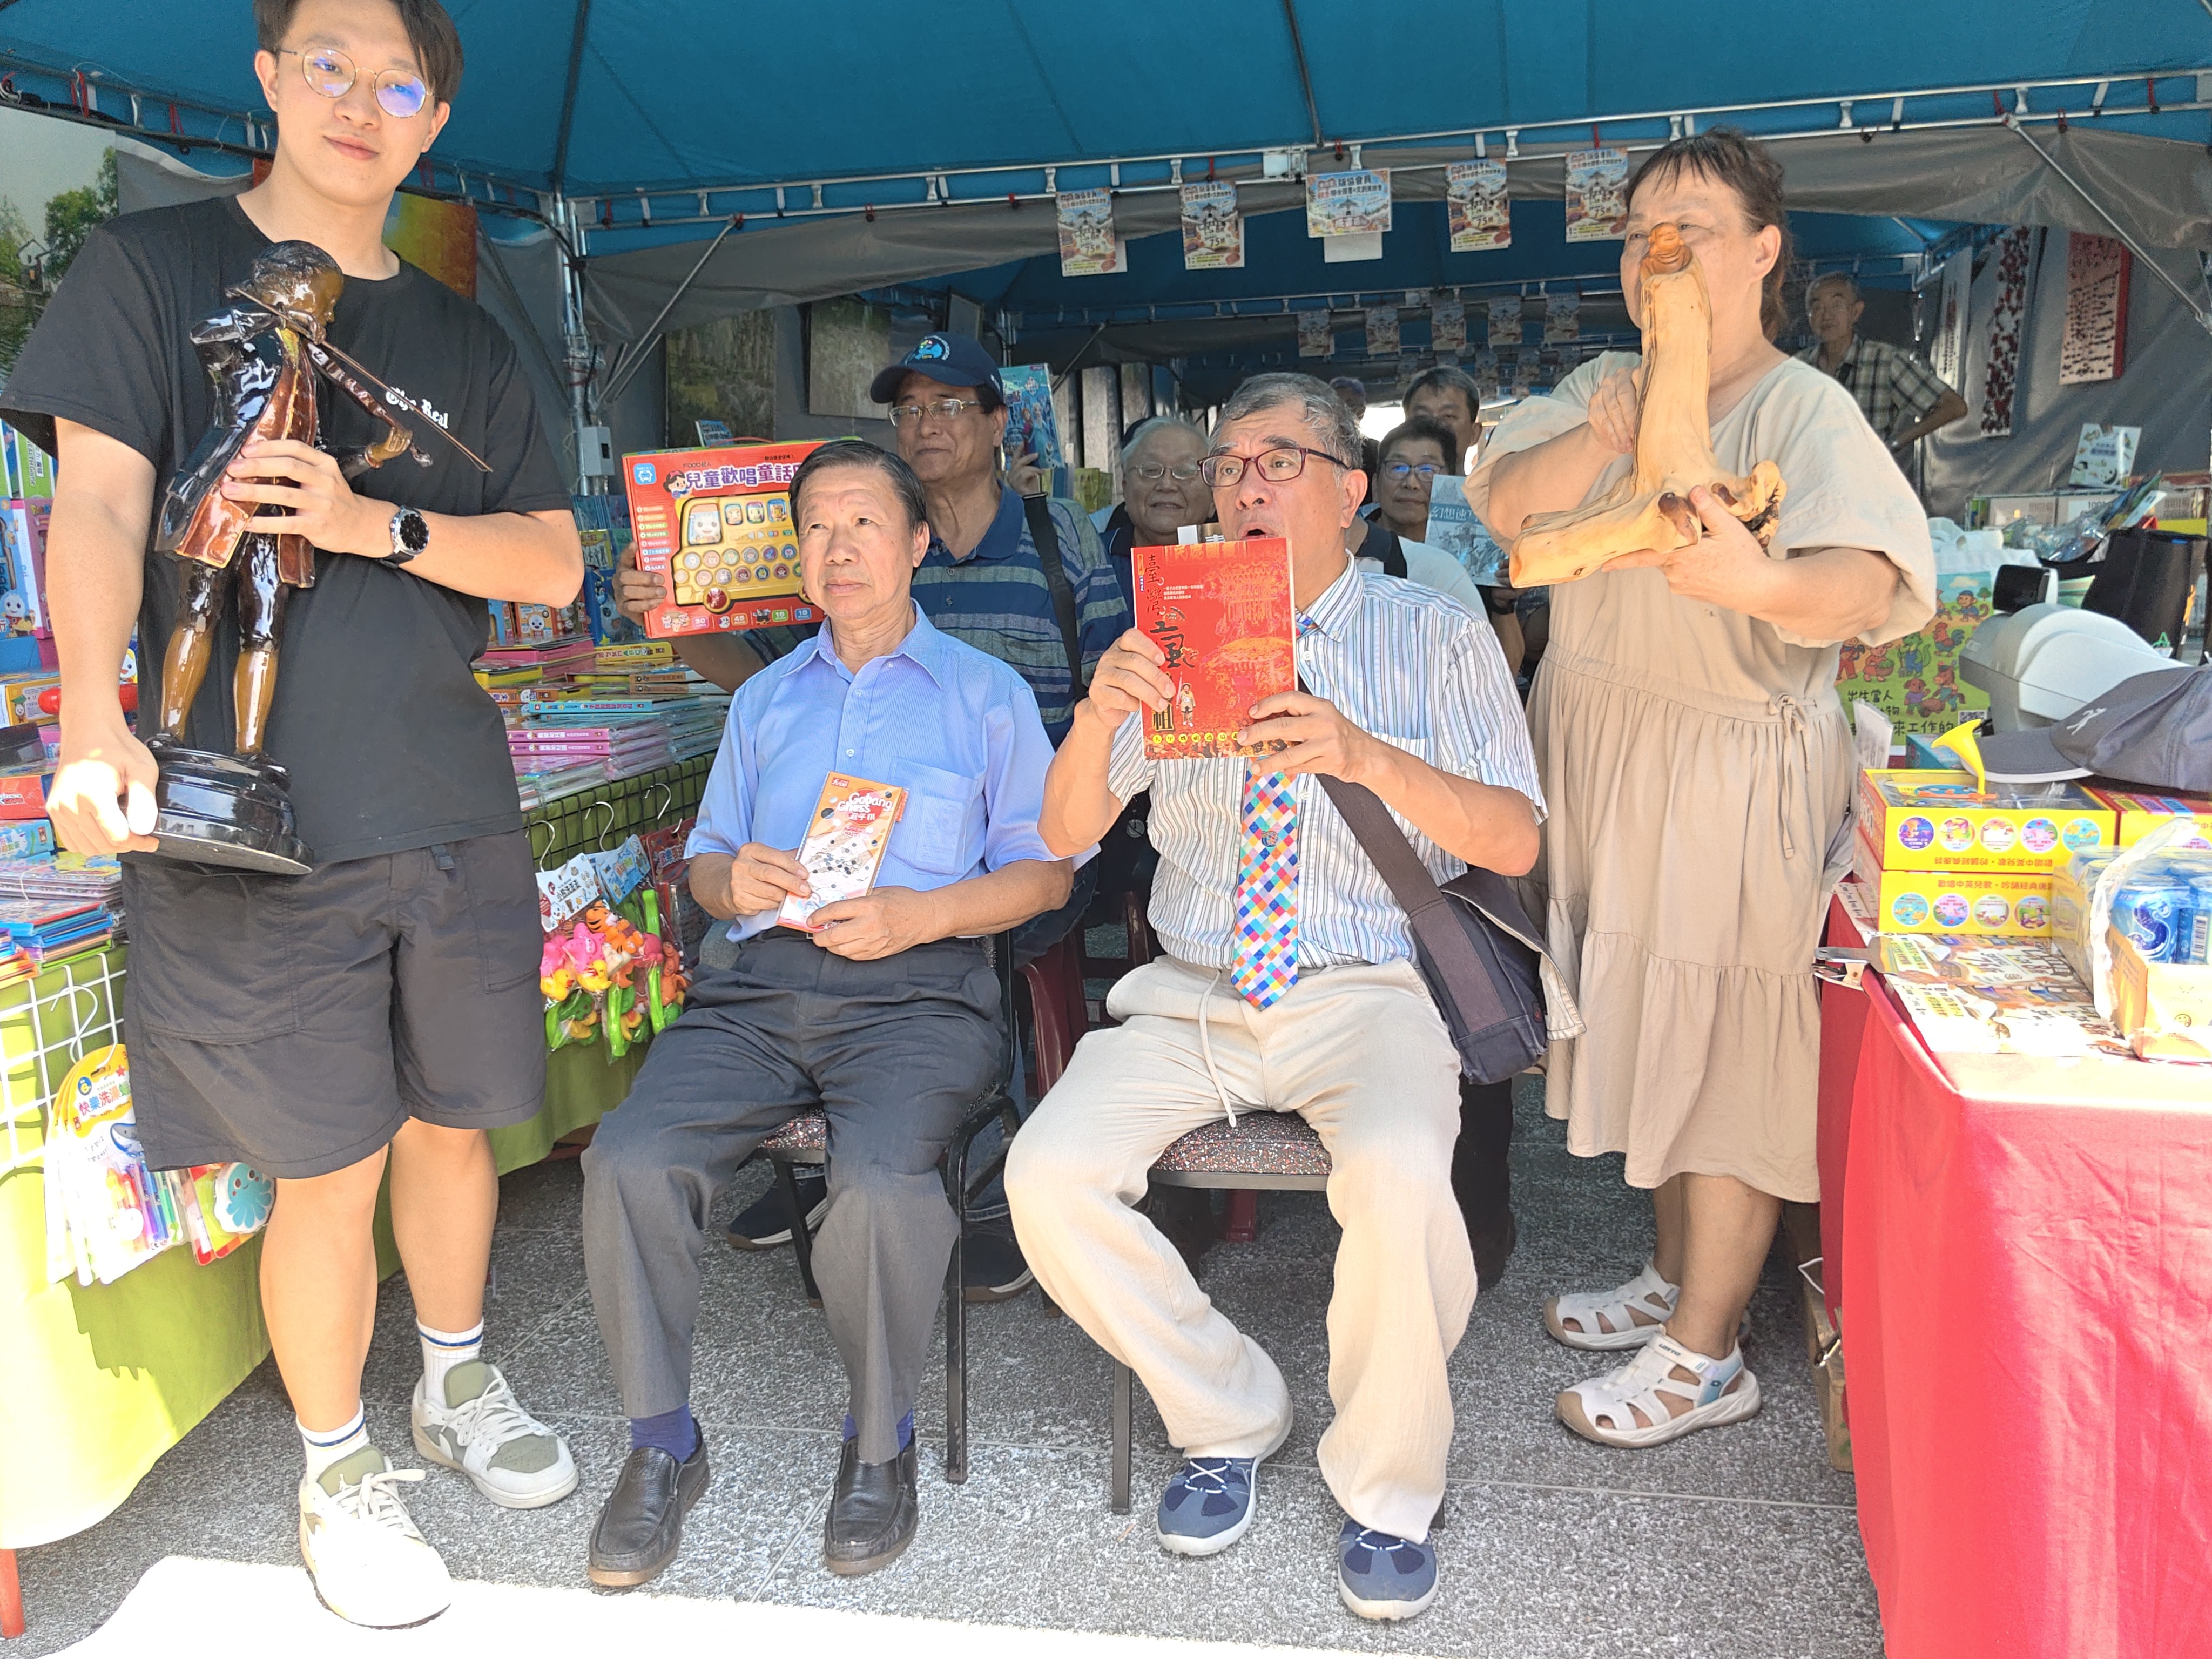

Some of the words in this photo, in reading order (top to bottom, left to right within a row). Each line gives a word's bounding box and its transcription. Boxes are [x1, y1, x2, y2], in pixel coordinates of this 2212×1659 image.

[422, 399, 449, 429] Real
[848, 792, 893, 812] Gobang
[849, 812, 875, 821] 五子棋
